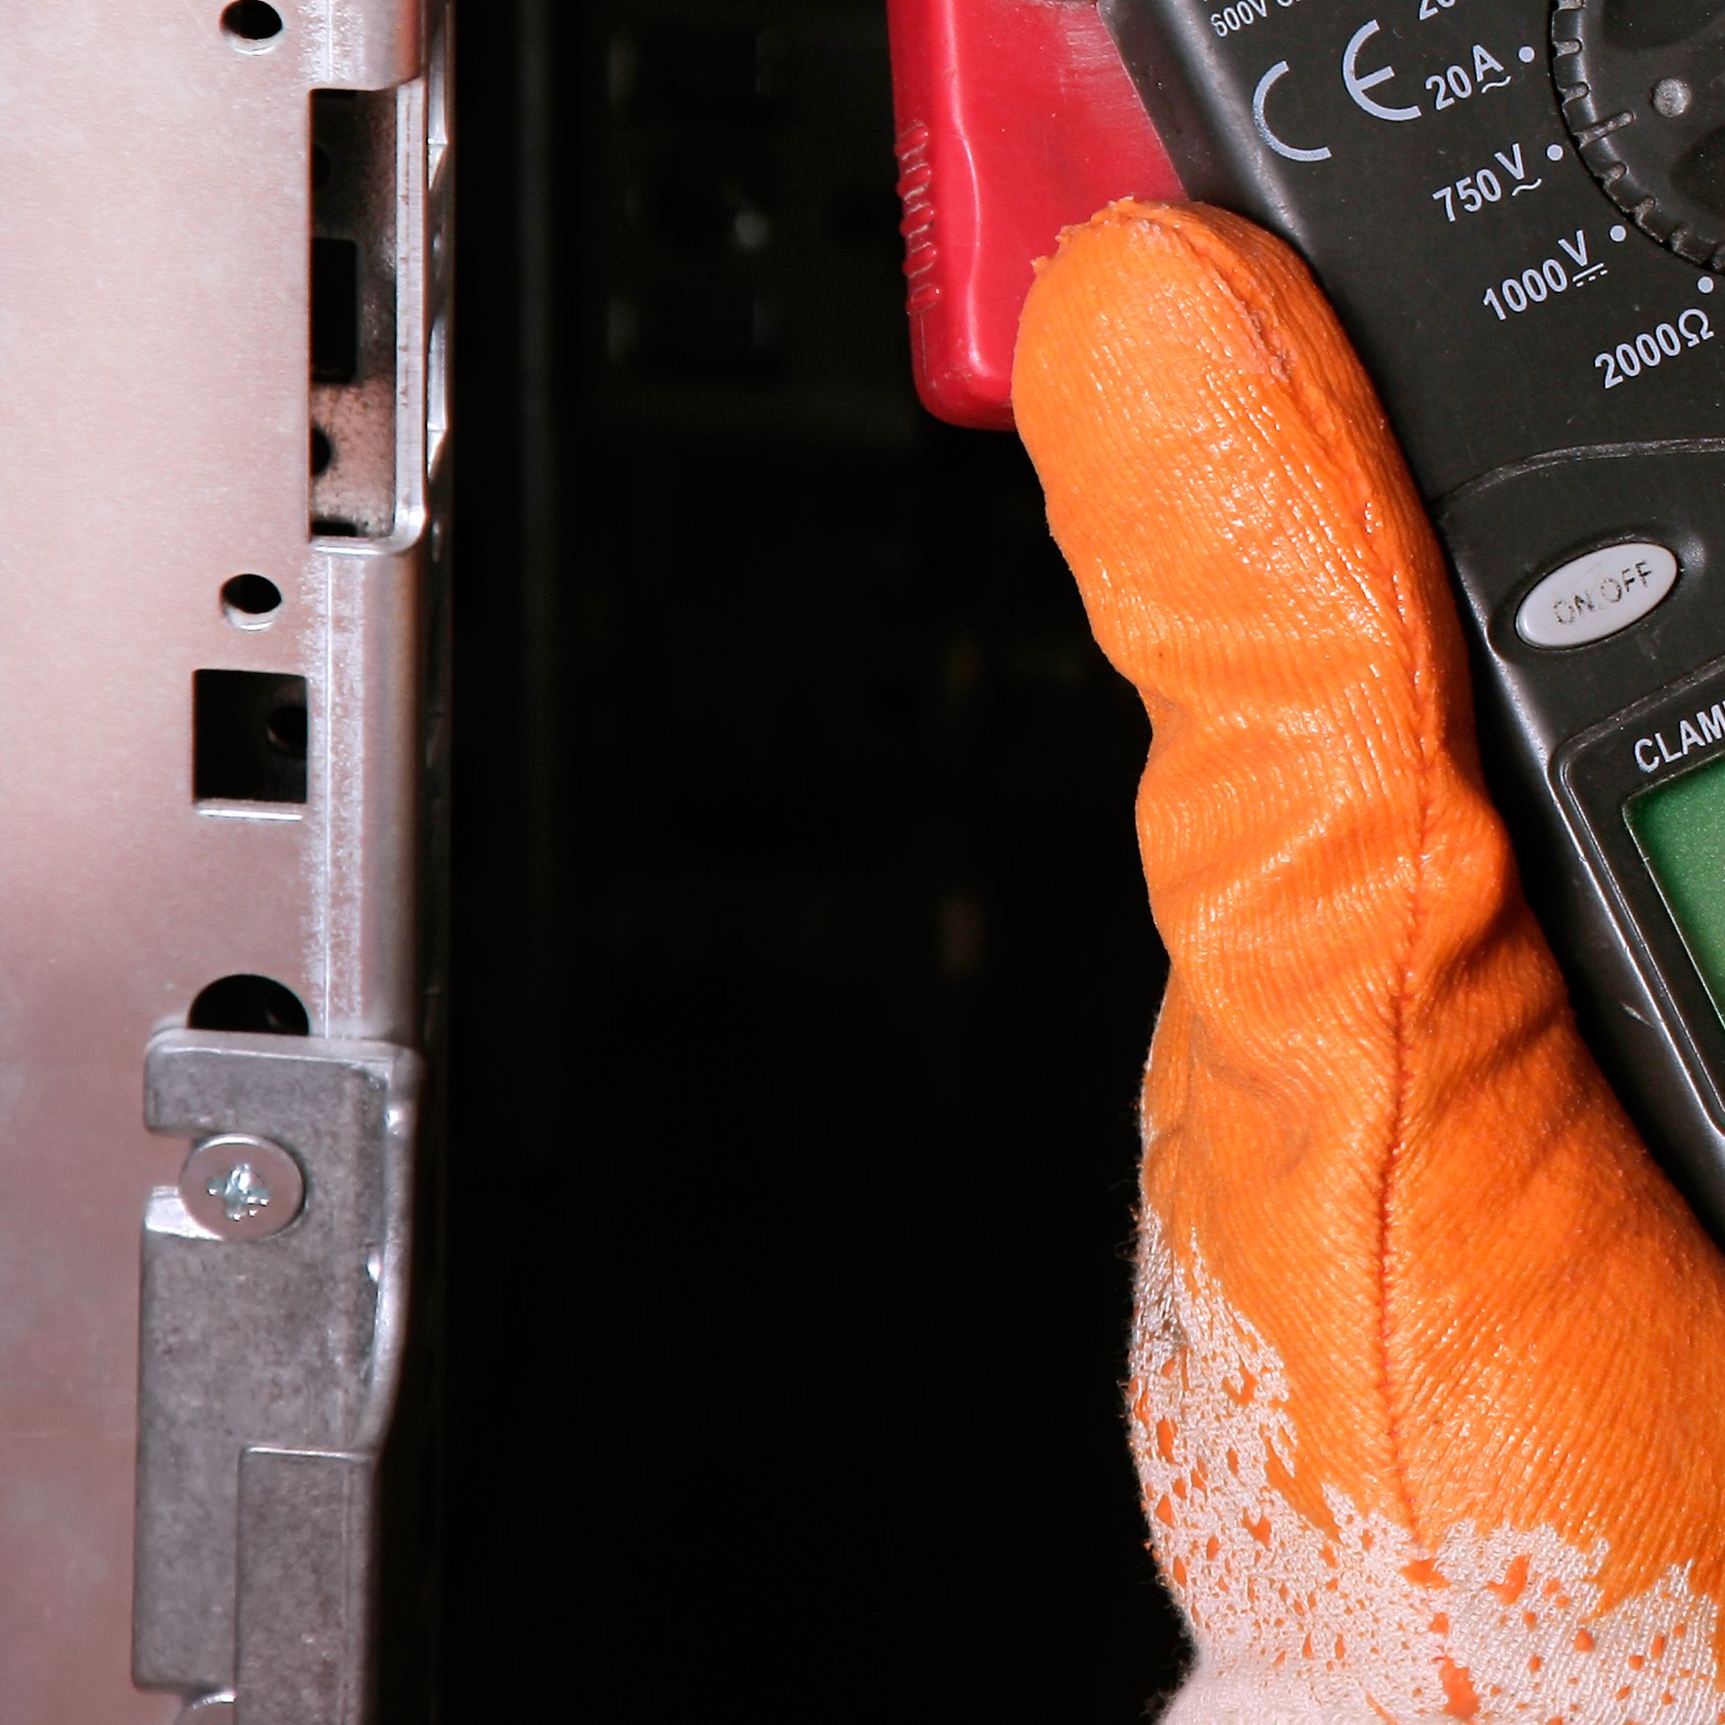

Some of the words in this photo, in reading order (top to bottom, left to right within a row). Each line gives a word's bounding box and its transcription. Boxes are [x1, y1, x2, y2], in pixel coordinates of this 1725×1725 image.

[1252, 19, 1422, 162] CE
[1425, 44, 1506, 111] 20A
[1432, 143, 1528, 222] 750V
[1483, 229, 1592, 320] 1000V
[1594, 308, 1715, 390] 2000Ω
